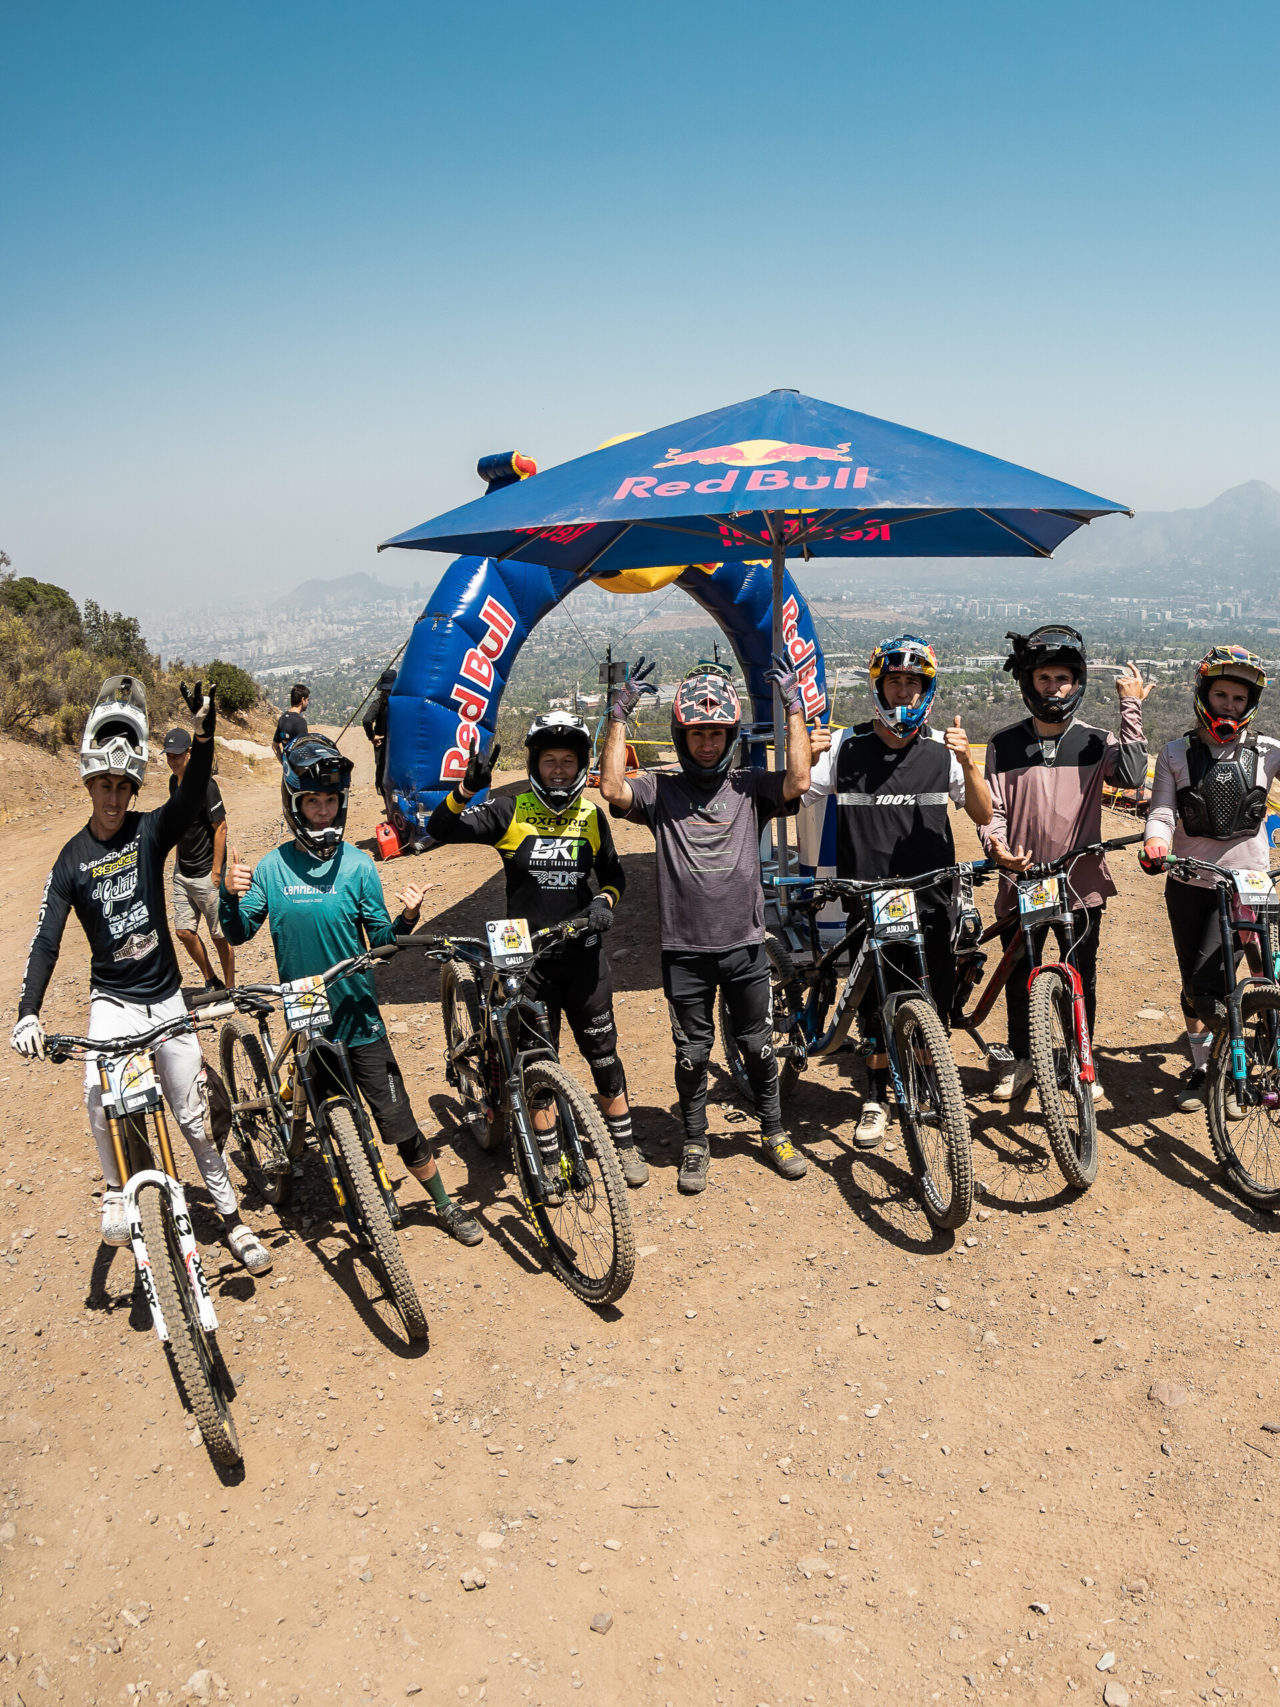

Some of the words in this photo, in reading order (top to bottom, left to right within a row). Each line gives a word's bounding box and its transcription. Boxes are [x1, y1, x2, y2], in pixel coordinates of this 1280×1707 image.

[613, 469, 740, 500] Red
[744, 466, 869, 491] Bull
[782, 594, 815, 666] Red
[460, 594, 516, 693] Bull
[796, 655, 827, 722] Bull
[439, 683, 489, 782] Red
[875, 794, 917, 806] 100%
[526, 816, 588, 828] OXFORD
[530, 838, 586, 860] BKT
[551, 860, 578, 868] TRAINING
[547, 871, 569, 886] 50
[284, 884, 338, 896] COMMENCAL
[886, 925, 910, 934] JURADO
[505, 956, 524, 966] GALLO
[140, 1267, 158, 1309] FOX
[191, 1257, 211, 1299] FOX
